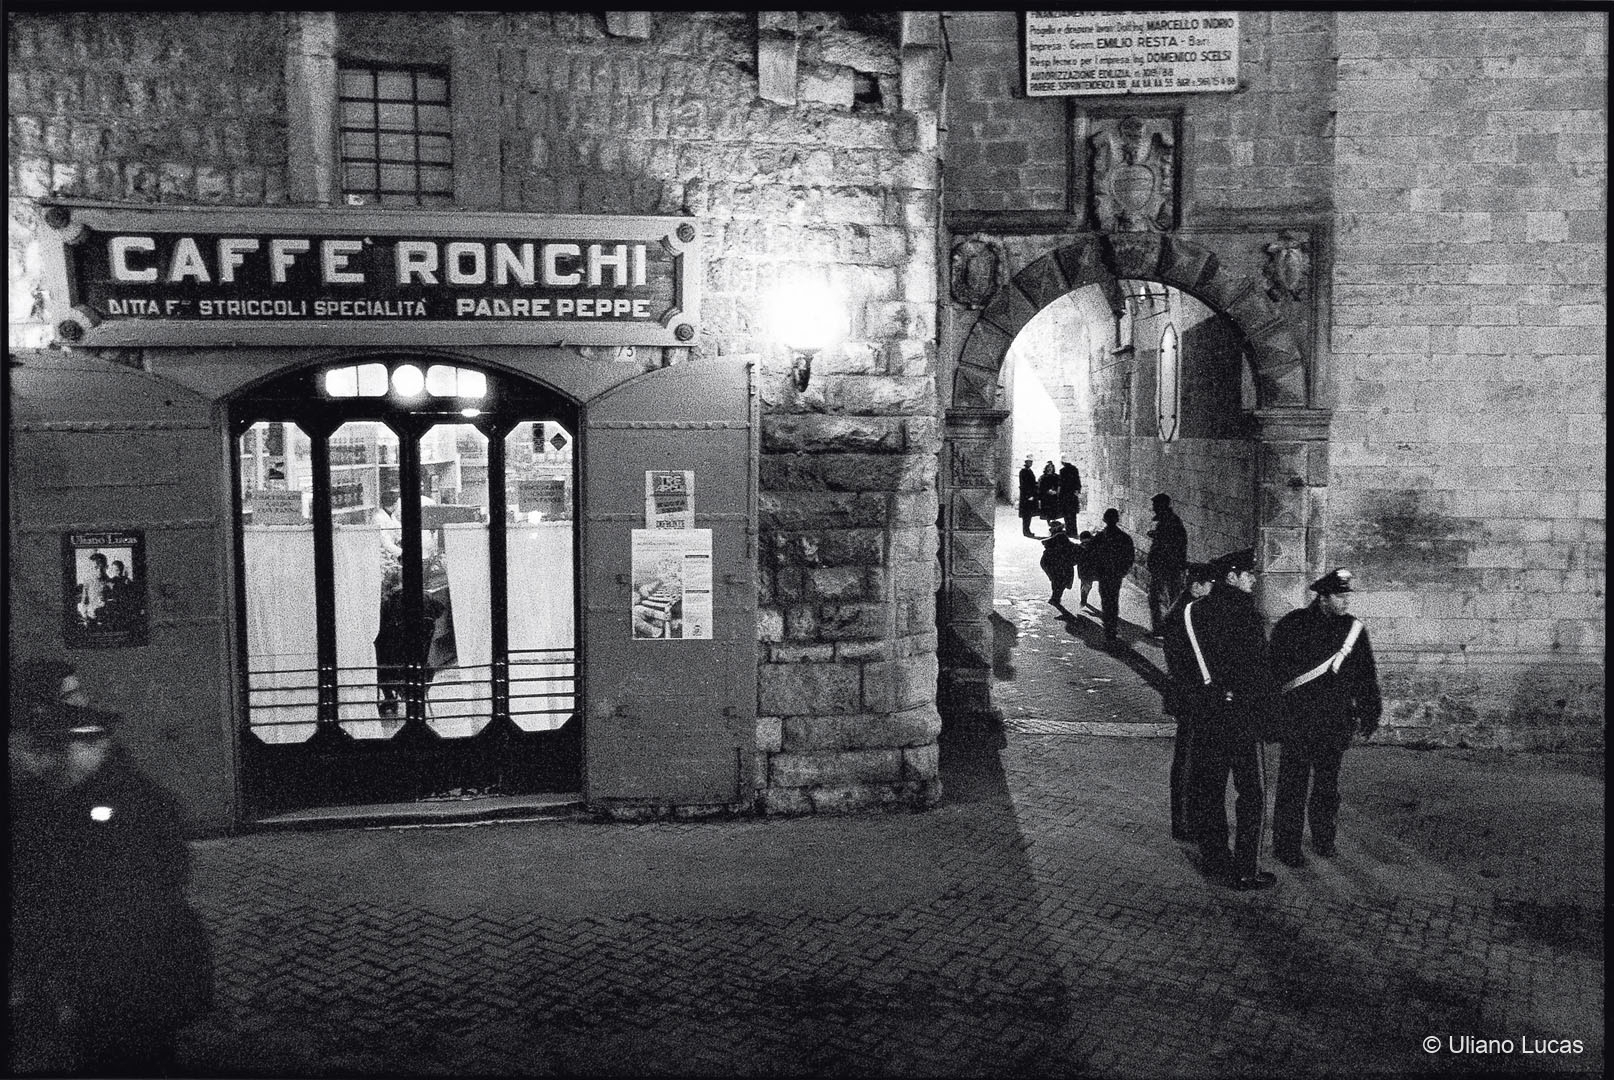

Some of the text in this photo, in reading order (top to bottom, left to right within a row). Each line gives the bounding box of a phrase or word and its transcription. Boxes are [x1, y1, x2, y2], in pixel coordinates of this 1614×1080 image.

[1147, 19, 1199, 31] MARCELLO
[1203, 18, 1234, 29] INDRIO
[1097, 38, 1132, 49] EMILIO
[1137, 36, 1178, 47] RESTA
[1188, 35, 1210, 46] Bari
[1147, 52, 1197, 63] DOMENICO
[1201, 51, 1231, 61] SCELSI
[1031, 70, 1096, 80] AUTORIZZAZIONE
[396, 241, 648, 287] RONCHI
[108, 300, 159, 315] DITTA
[199, 300, 307, 316] STRICCOLI
[456, 298, 550, 317] PADRE
[556, 299, 651, 318] PEPPE
